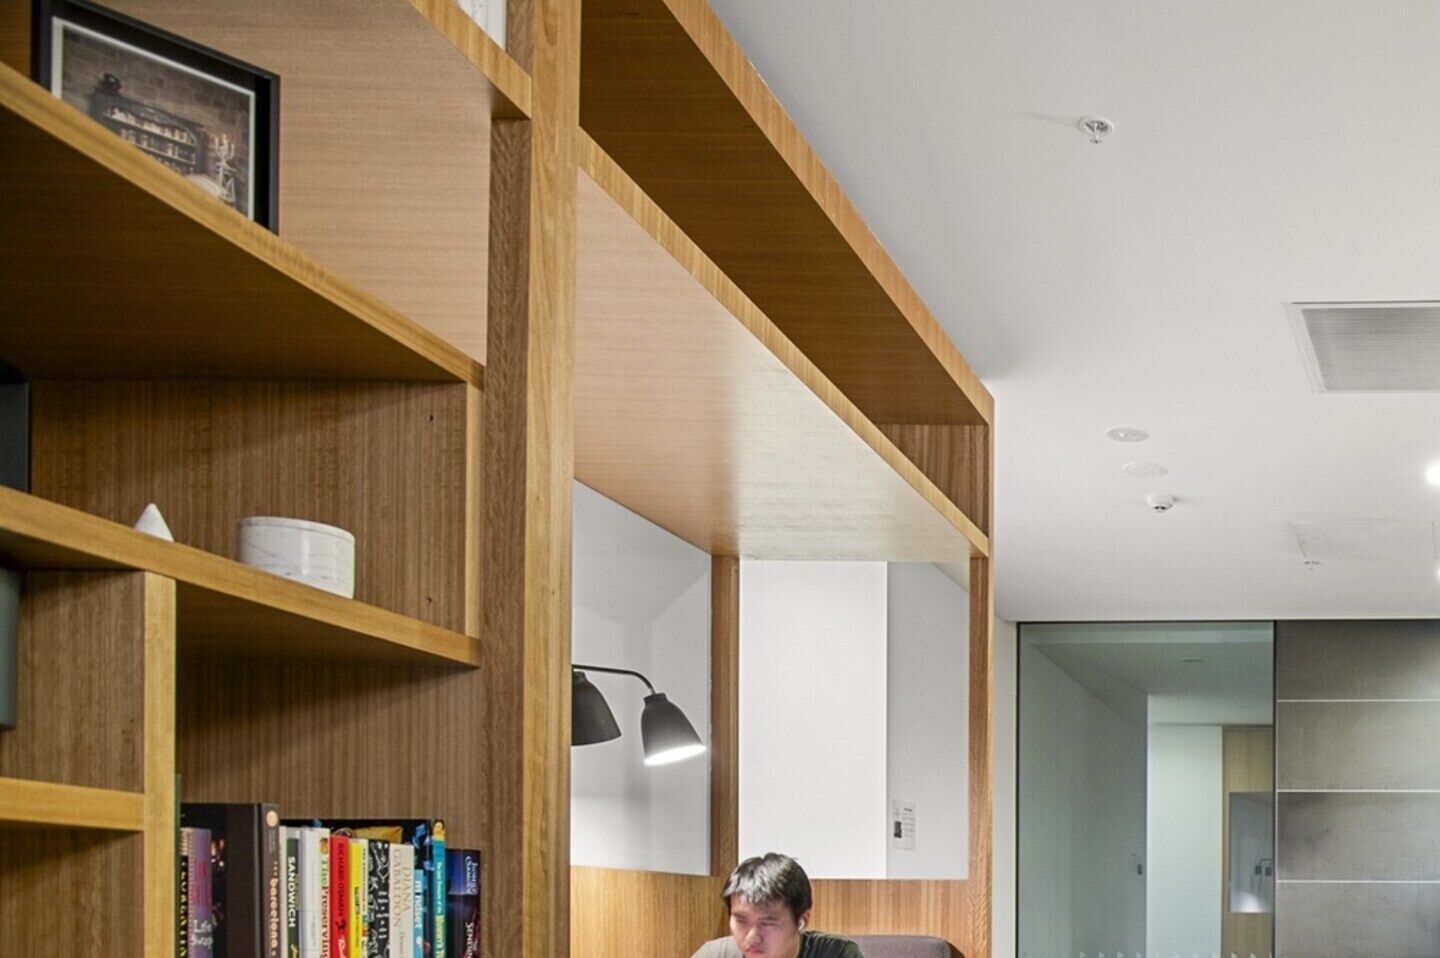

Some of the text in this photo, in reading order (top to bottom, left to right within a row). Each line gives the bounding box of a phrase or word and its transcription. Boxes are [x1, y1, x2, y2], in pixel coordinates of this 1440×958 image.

[269, 878, 279, 948] barcelona
[287, 856, 296, 928] SANDWICH
[392, 849, 401, 928] GABALDON
[402, 866, 412, 912] DIANA
[193, 919, 212, 933] Life
